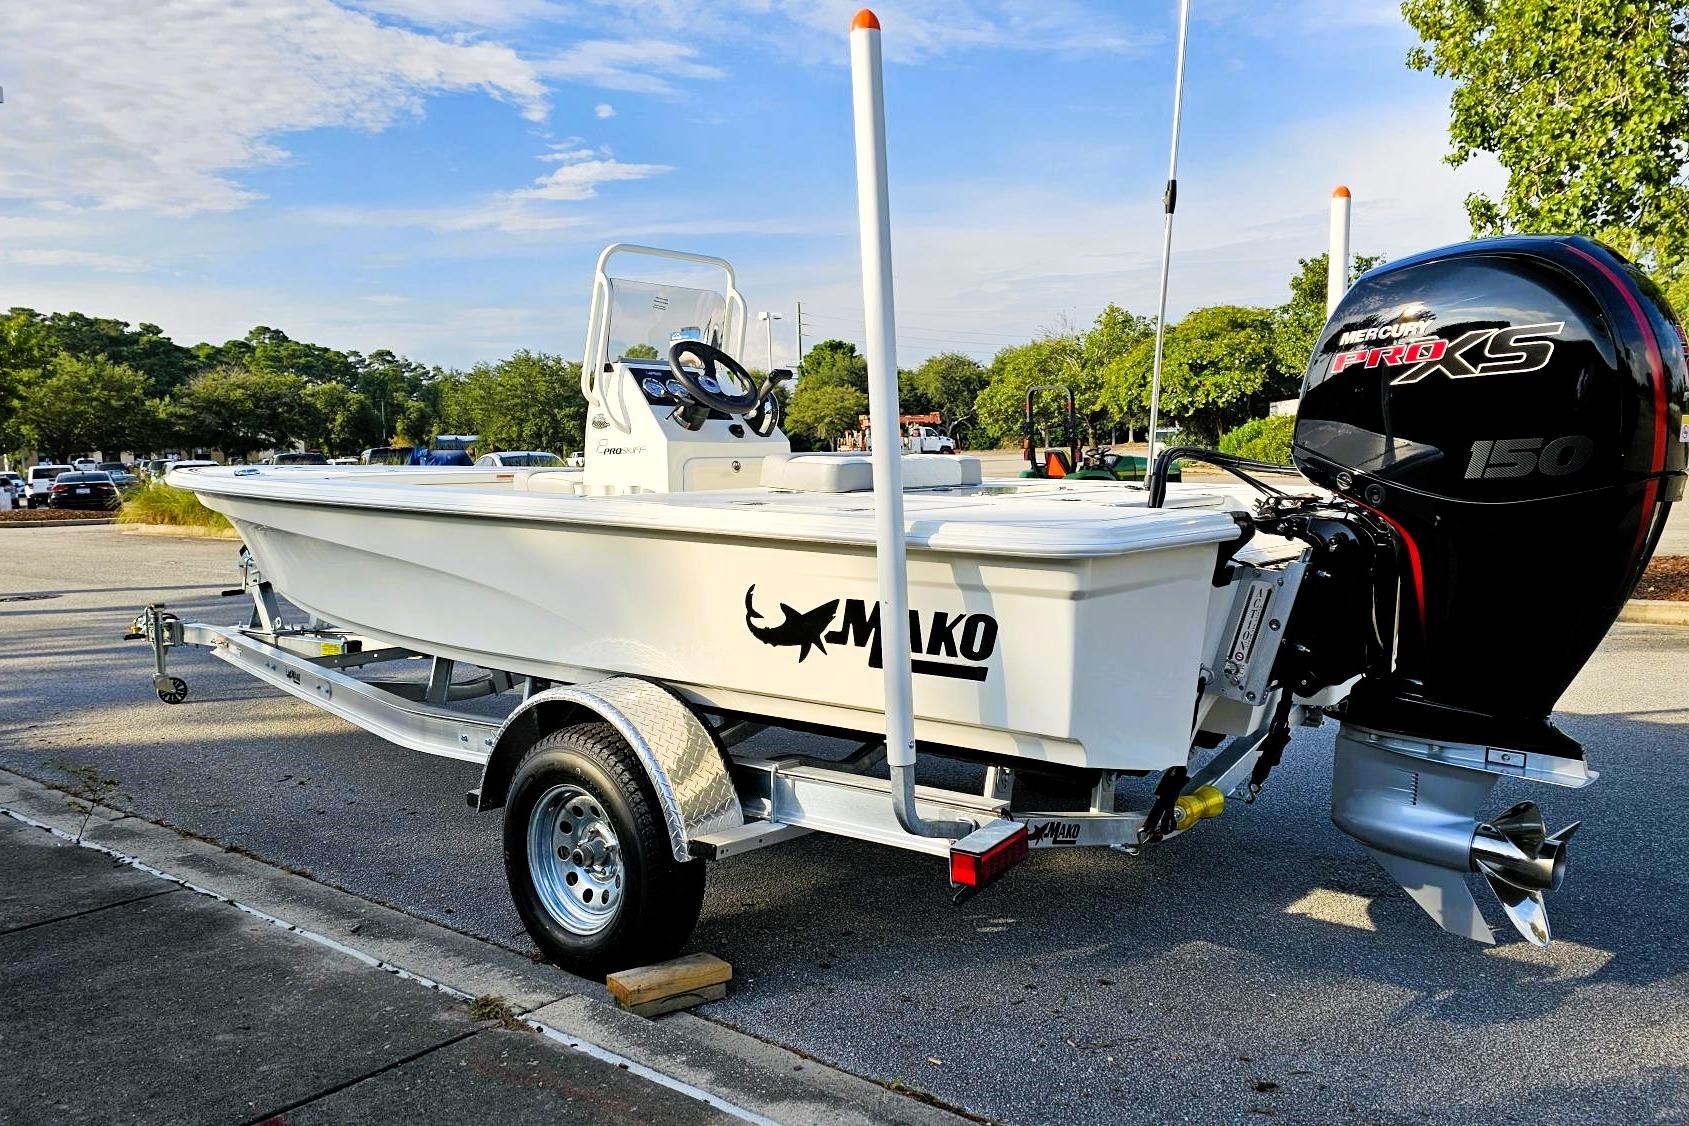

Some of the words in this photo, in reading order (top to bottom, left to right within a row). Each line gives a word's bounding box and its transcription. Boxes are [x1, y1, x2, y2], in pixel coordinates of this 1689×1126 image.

[1339, 320, 1433, 346] MERCURY
[1331, 338, 1449, 374] PRO
[1390, 321, 1566, 386] XS
[1464, 435, 1594, 480] 150
[1043, 821, 1081, 845] MAKO
